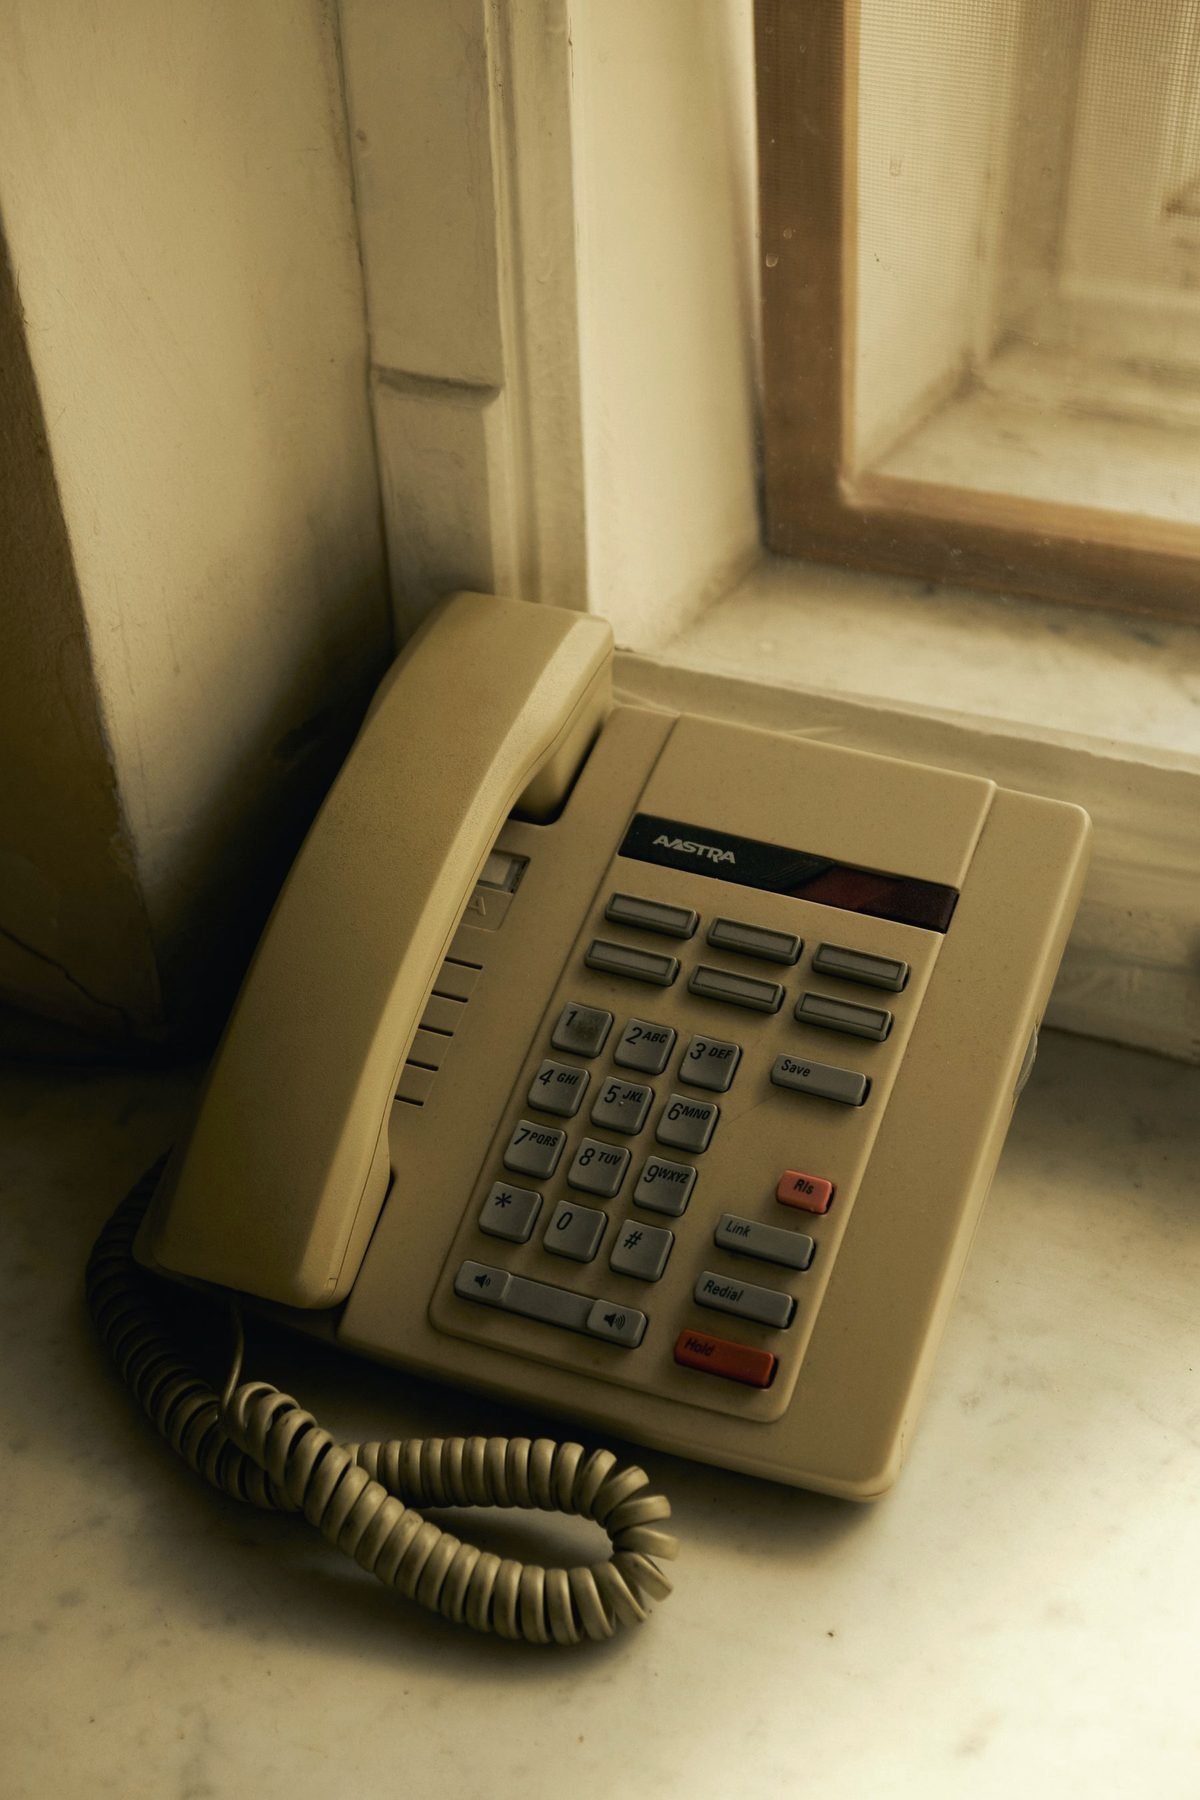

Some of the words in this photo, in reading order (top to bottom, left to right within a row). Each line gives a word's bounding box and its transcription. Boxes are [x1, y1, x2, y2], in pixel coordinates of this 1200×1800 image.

[565, 1010, 578, 1027] 1
[625, 1026, 643, 1045] 2
[642, 1031, 668, 1044] ABC
[690, 1042, 706, 1060] 3
[708, 1047, 733, 1060] DEF
[539, 1069, 554, 1086] 4
[556, 1072, 579, 1086] GHI
[781, 1059, 811, 1077] Save
[604, 1085, 621, 1104] 5
[622, 1090, 643, 1104] JKL
[668, 1102, 685, 1121] 6
[681, 1105, 711, 1120] MNO
[513, 1128, 531, 1145] 7
[529, 1133, 559, 1148] PQRS
[578, 1148, 596, 1166] 8
[597, 1151, 622, 1166] TUV
[643, 1164, 660, 1183] 9
[657, 1167, 690, 1184] WXYZ
[556, 1211, 573, 1231] 0
[725, 1220, 751, 1238] Link
[624, 1231, 643, 1249] #
[703, 1279, 745, 1302] Redial
[684, 1337, 715, 1356] Hold
